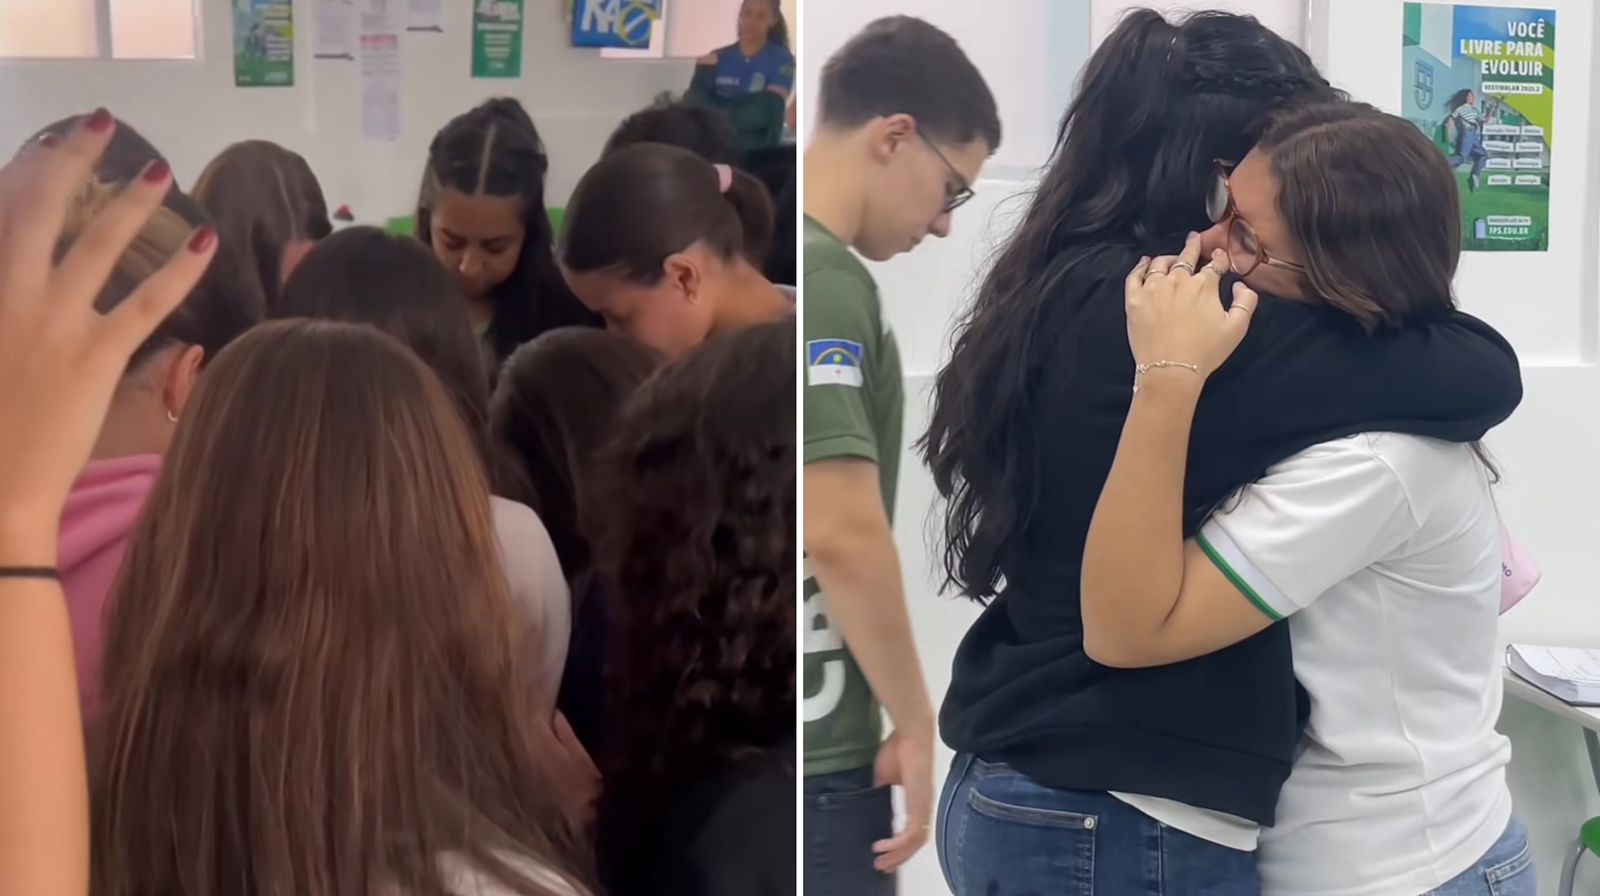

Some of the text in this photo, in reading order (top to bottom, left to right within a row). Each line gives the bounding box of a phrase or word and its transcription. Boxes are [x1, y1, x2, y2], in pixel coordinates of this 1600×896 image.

[1507, 17, 1545, 38] VOCÊ
[1460, 39, 1544, 57] LIVRE PARA
[1481, 59, 1543, 76] EVOLUIR
